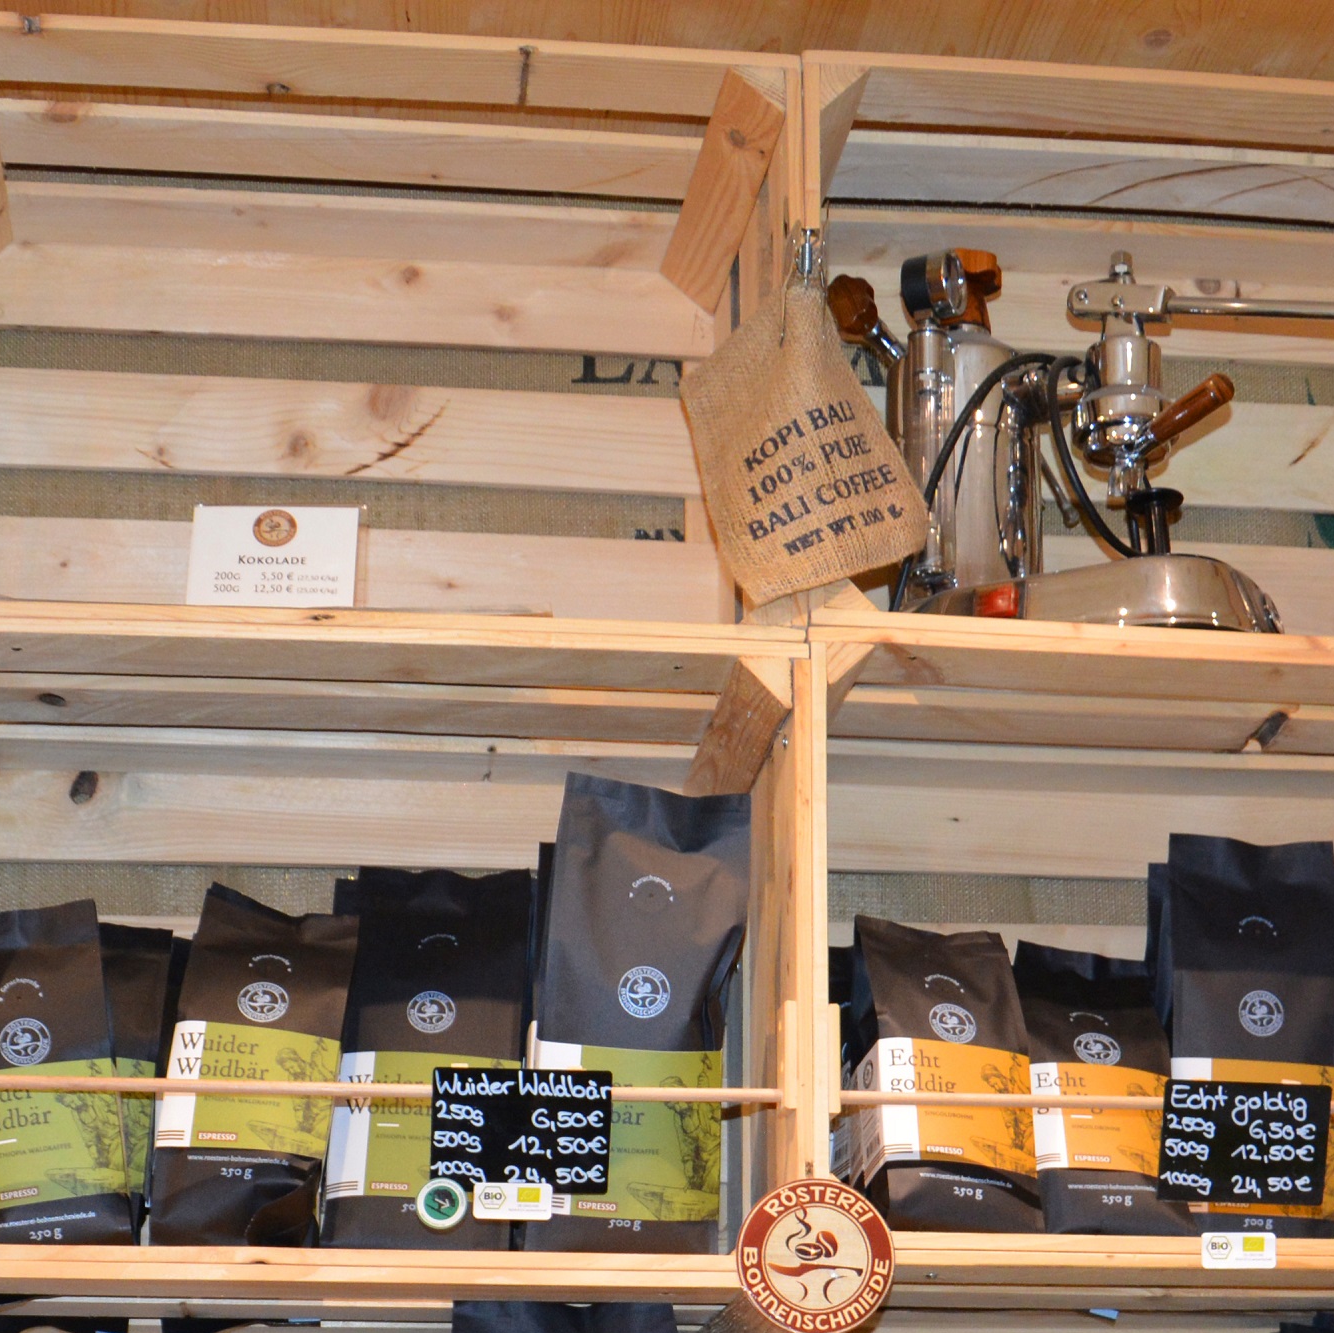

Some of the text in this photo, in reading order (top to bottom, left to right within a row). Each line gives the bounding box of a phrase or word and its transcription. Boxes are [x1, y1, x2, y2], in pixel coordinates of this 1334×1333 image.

[744, 400, 855, 472] KOPI BALI
[748, 453, 816, 505] 100%
[746, 464, 897, 540] BALI COFFEE
[783, 531, 825, 555] NET
[830, 516, 857, 539] WT
[181, 1032, 259, 1055] Wuider
[177, 1057, 269, 1080] Woidbär
[888, 1048, 940, 1068] Echt
[434, 1068, 612, 1101] Wuider Waldbär
[890, 1074, 957, 1093] goldig
[1035, 1072, 1085, 1088] Echt
[435, 1100, 604, 1132] 250g 6,50€
[1170, 1085, 1308, 1126] Echt goldig
[198, 1132, 236, 1141] ESPRESSO
[433, 1131, 482, 1153] 500g
[1248, 1121, 1316, 1144] 6,50€
[927, 1146, 963, 1155] ESPRESSO
[1231, 1145, 1314, 1164] 12,50€
[578, 1201, 616, 1211] ESPRESSO
[763, 1186, 874, 1223] RÖSTEREI
[743, 1247, 890, 1330] BOHNENSCHMIEDE
